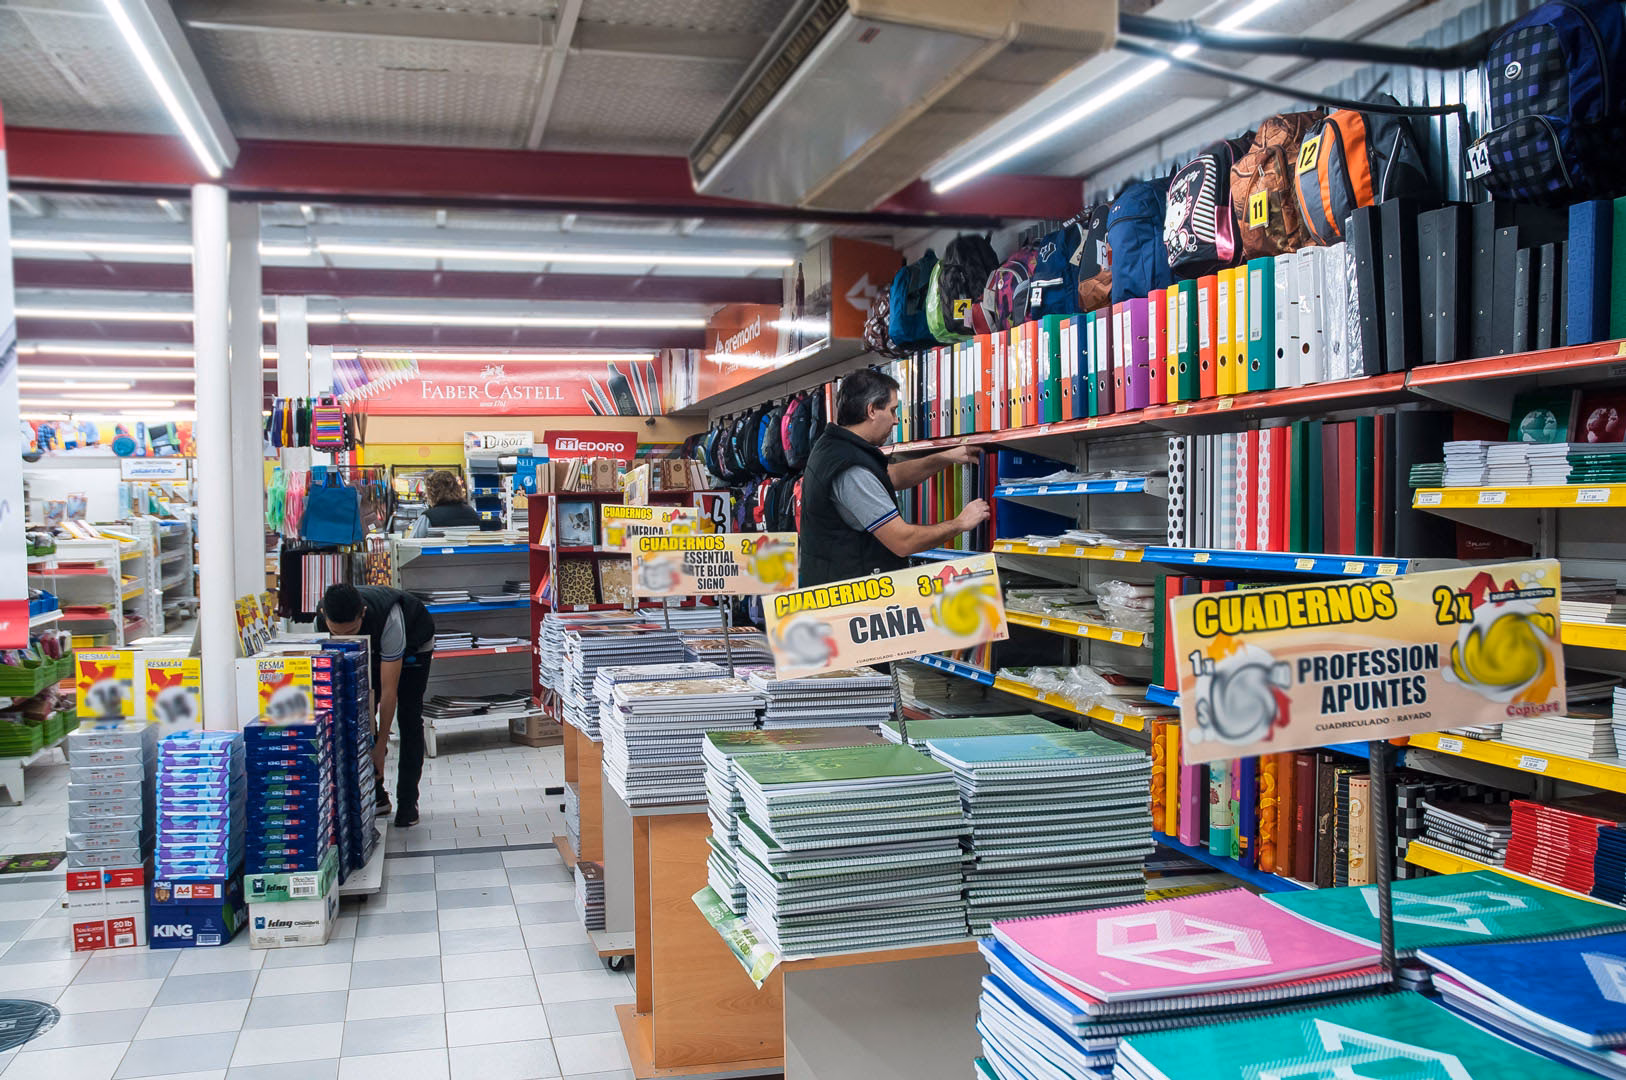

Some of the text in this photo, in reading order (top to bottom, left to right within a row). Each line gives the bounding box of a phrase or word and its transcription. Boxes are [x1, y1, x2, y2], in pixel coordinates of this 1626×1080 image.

[1299, 142, 1317, 169] 12
[1472, 149, 1488, 170] 14
[1253, 199, 1263, 220] 11
[421, 380, 565, 400] FABER-CASTELL
[603, 506, 653, 520] CUADERNOS
[639, 536, 725, 552] CUADERNOS
[684, 551, 735, 564] ESSENTIAL
[707, 564, 739, 577] BLOOM
[697, 577, 725, 590] SIGNO
[775, 576, 894, 618] CUADERNOS
[1194, 580, 1398, 638] CUADERNOS
[849, 605, 926, 644] CAÑA
[147, 660, 182, 668] RESMA A4
[258, 661, 285, 670] RESMA
[1297, 643, 1439, 684] PROFESSION
[1321, 675, 1427, 715] APUNTES
[1316, 711, 1432, 732] CUADRICULADO RAYADO
[176, 886, 190, 894] A4
[113, 921, 126, 929] 20
[153, 924, 194, 938] KING
